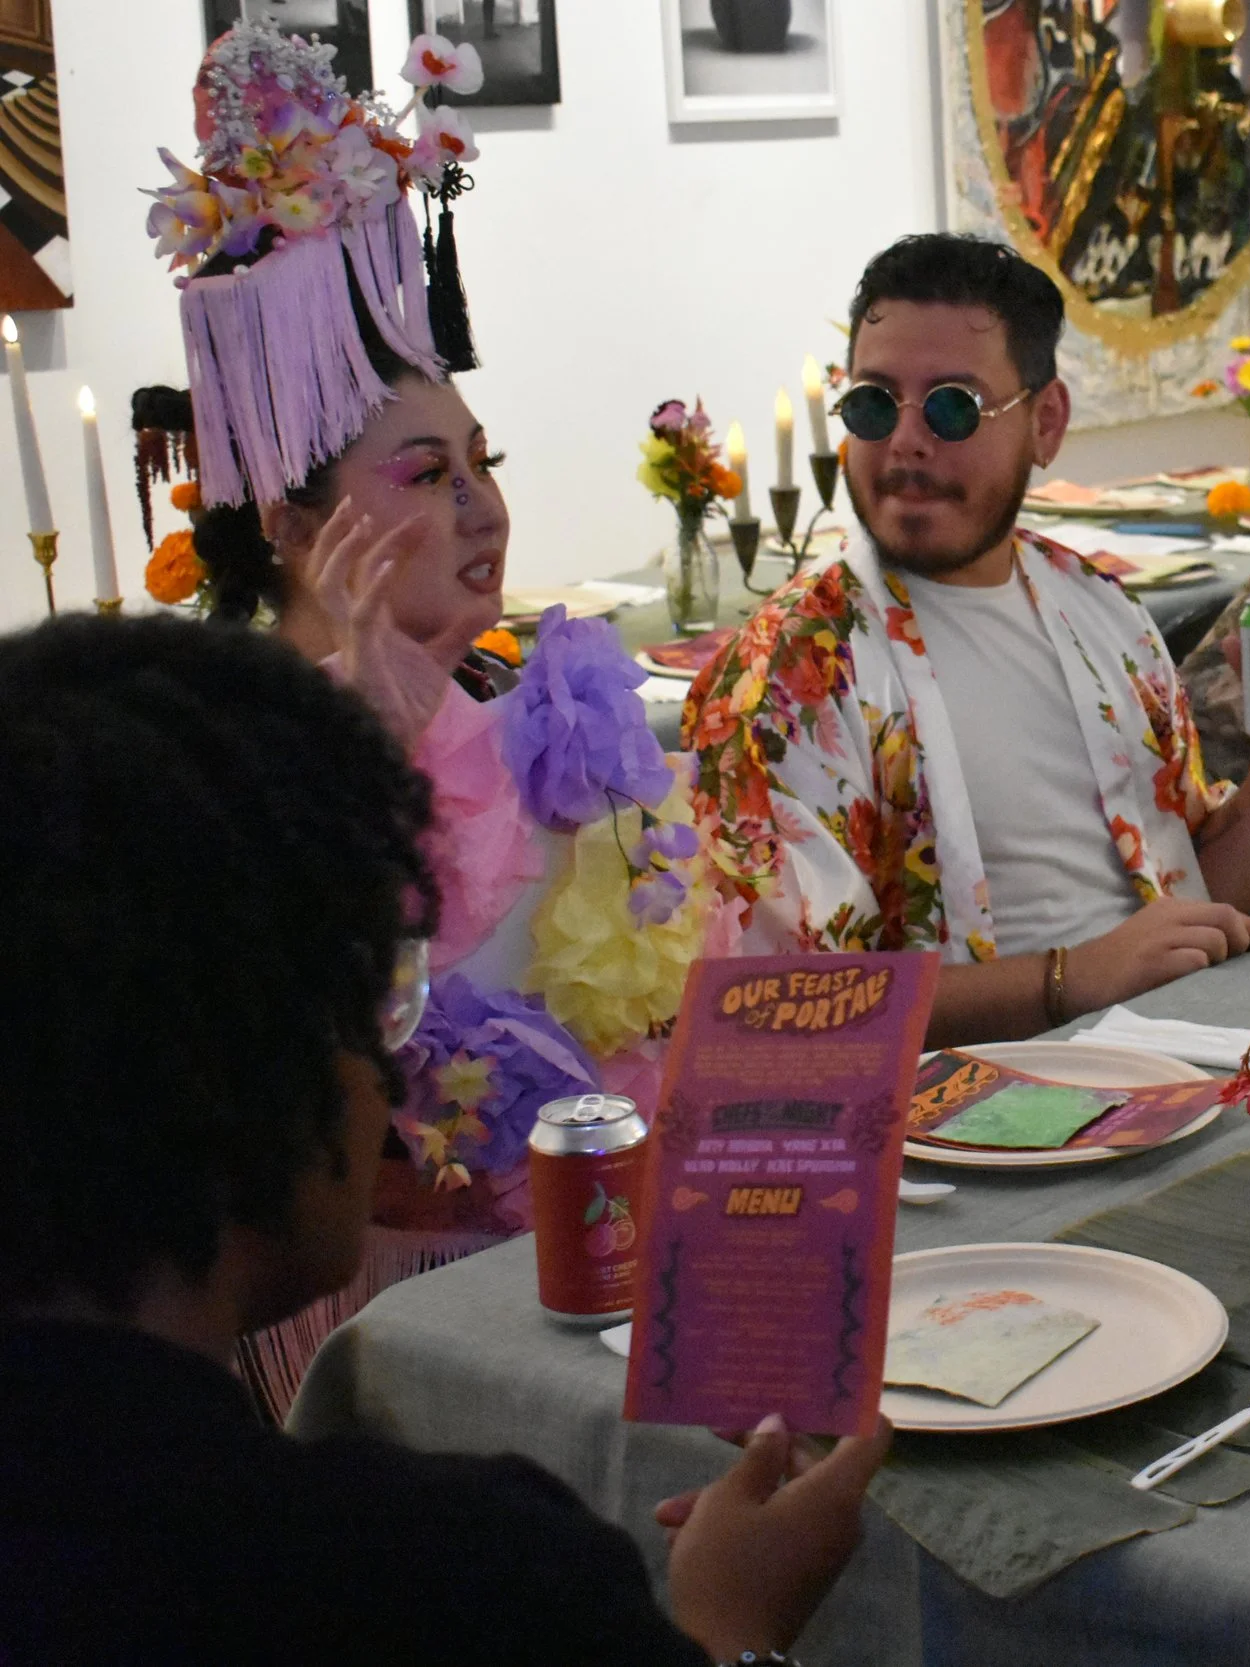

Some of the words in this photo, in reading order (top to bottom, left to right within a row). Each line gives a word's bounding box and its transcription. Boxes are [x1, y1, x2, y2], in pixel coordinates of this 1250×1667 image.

[722, 977, 781, 1015] OUR
[789, 967, 862, 998] FEAST
[744, 1001, 776, 1030] of
[771, 968, 889, 1030] PORTALS
[726, 1187, 802, 1215] MENU
